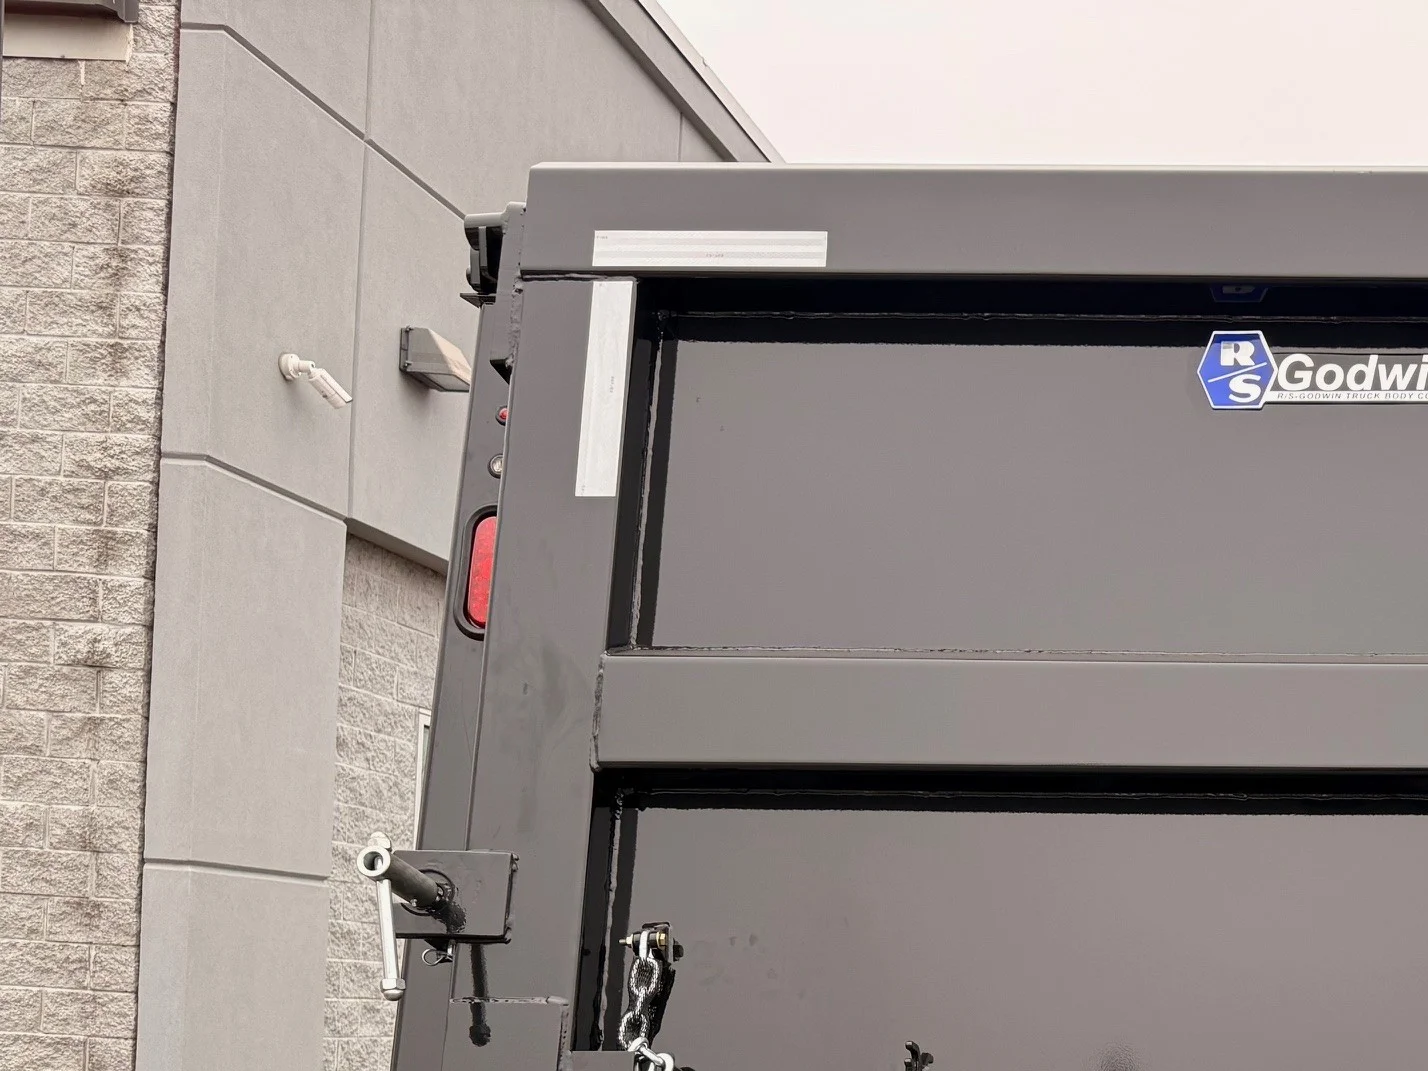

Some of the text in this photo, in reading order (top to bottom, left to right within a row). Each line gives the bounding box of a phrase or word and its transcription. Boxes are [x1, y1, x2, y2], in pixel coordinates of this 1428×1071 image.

[1277, 392, 1342, 400] R/S-GODWIN
[1346, 392, 1380, 400] TRUCK
[1384, 392, 1414, 400] BODY
